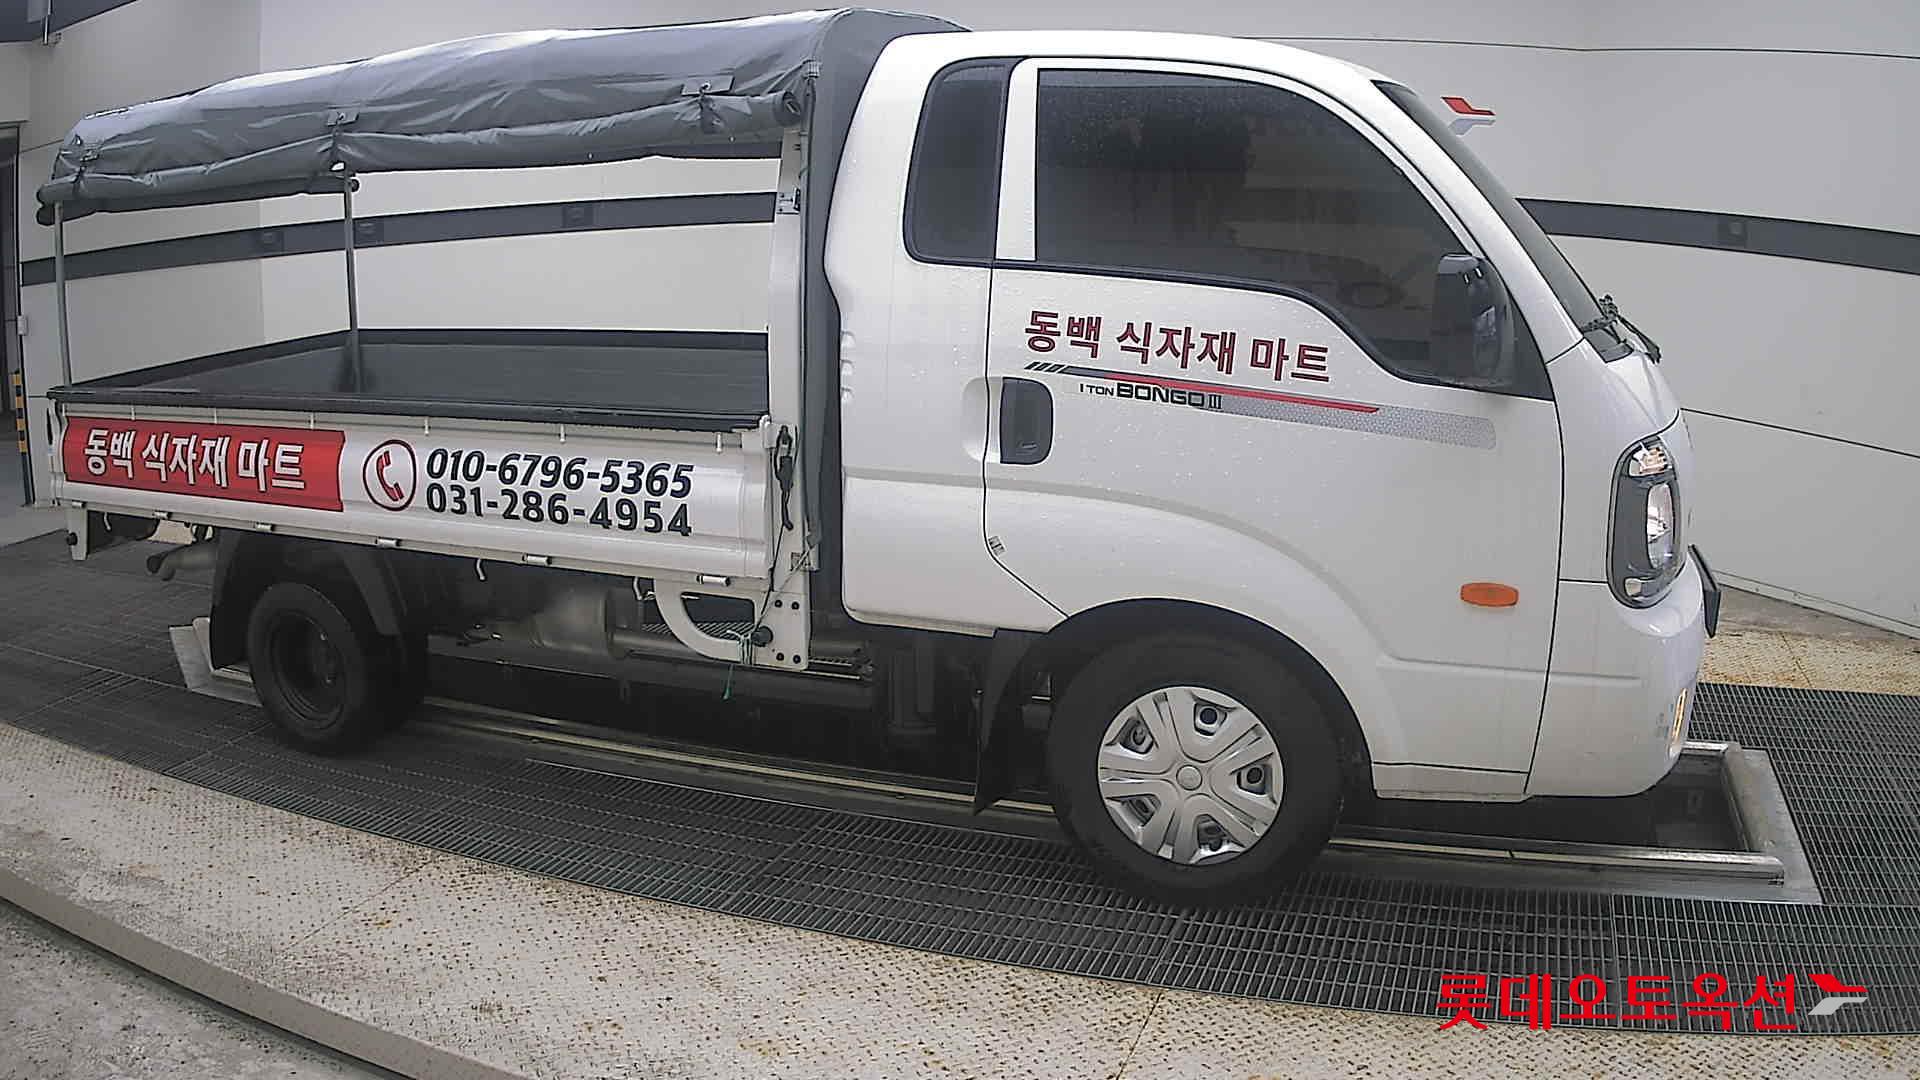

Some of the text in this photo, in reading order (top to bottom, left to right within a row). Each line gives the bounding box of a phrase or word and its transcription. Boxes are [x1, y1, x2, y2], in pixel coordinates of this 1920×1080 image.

[1024, 310, 1331, 383] 동백 식자재 마트
[1086, 384, 1114, 396] TON
[1116, 382, 1205, 407] BONGO
[84, 428, 306, 492] 동백 식자재 마트
[426, 448, 694, 498] 010-6796-5365
[426, 483, 692, 536] 031-286-4954
